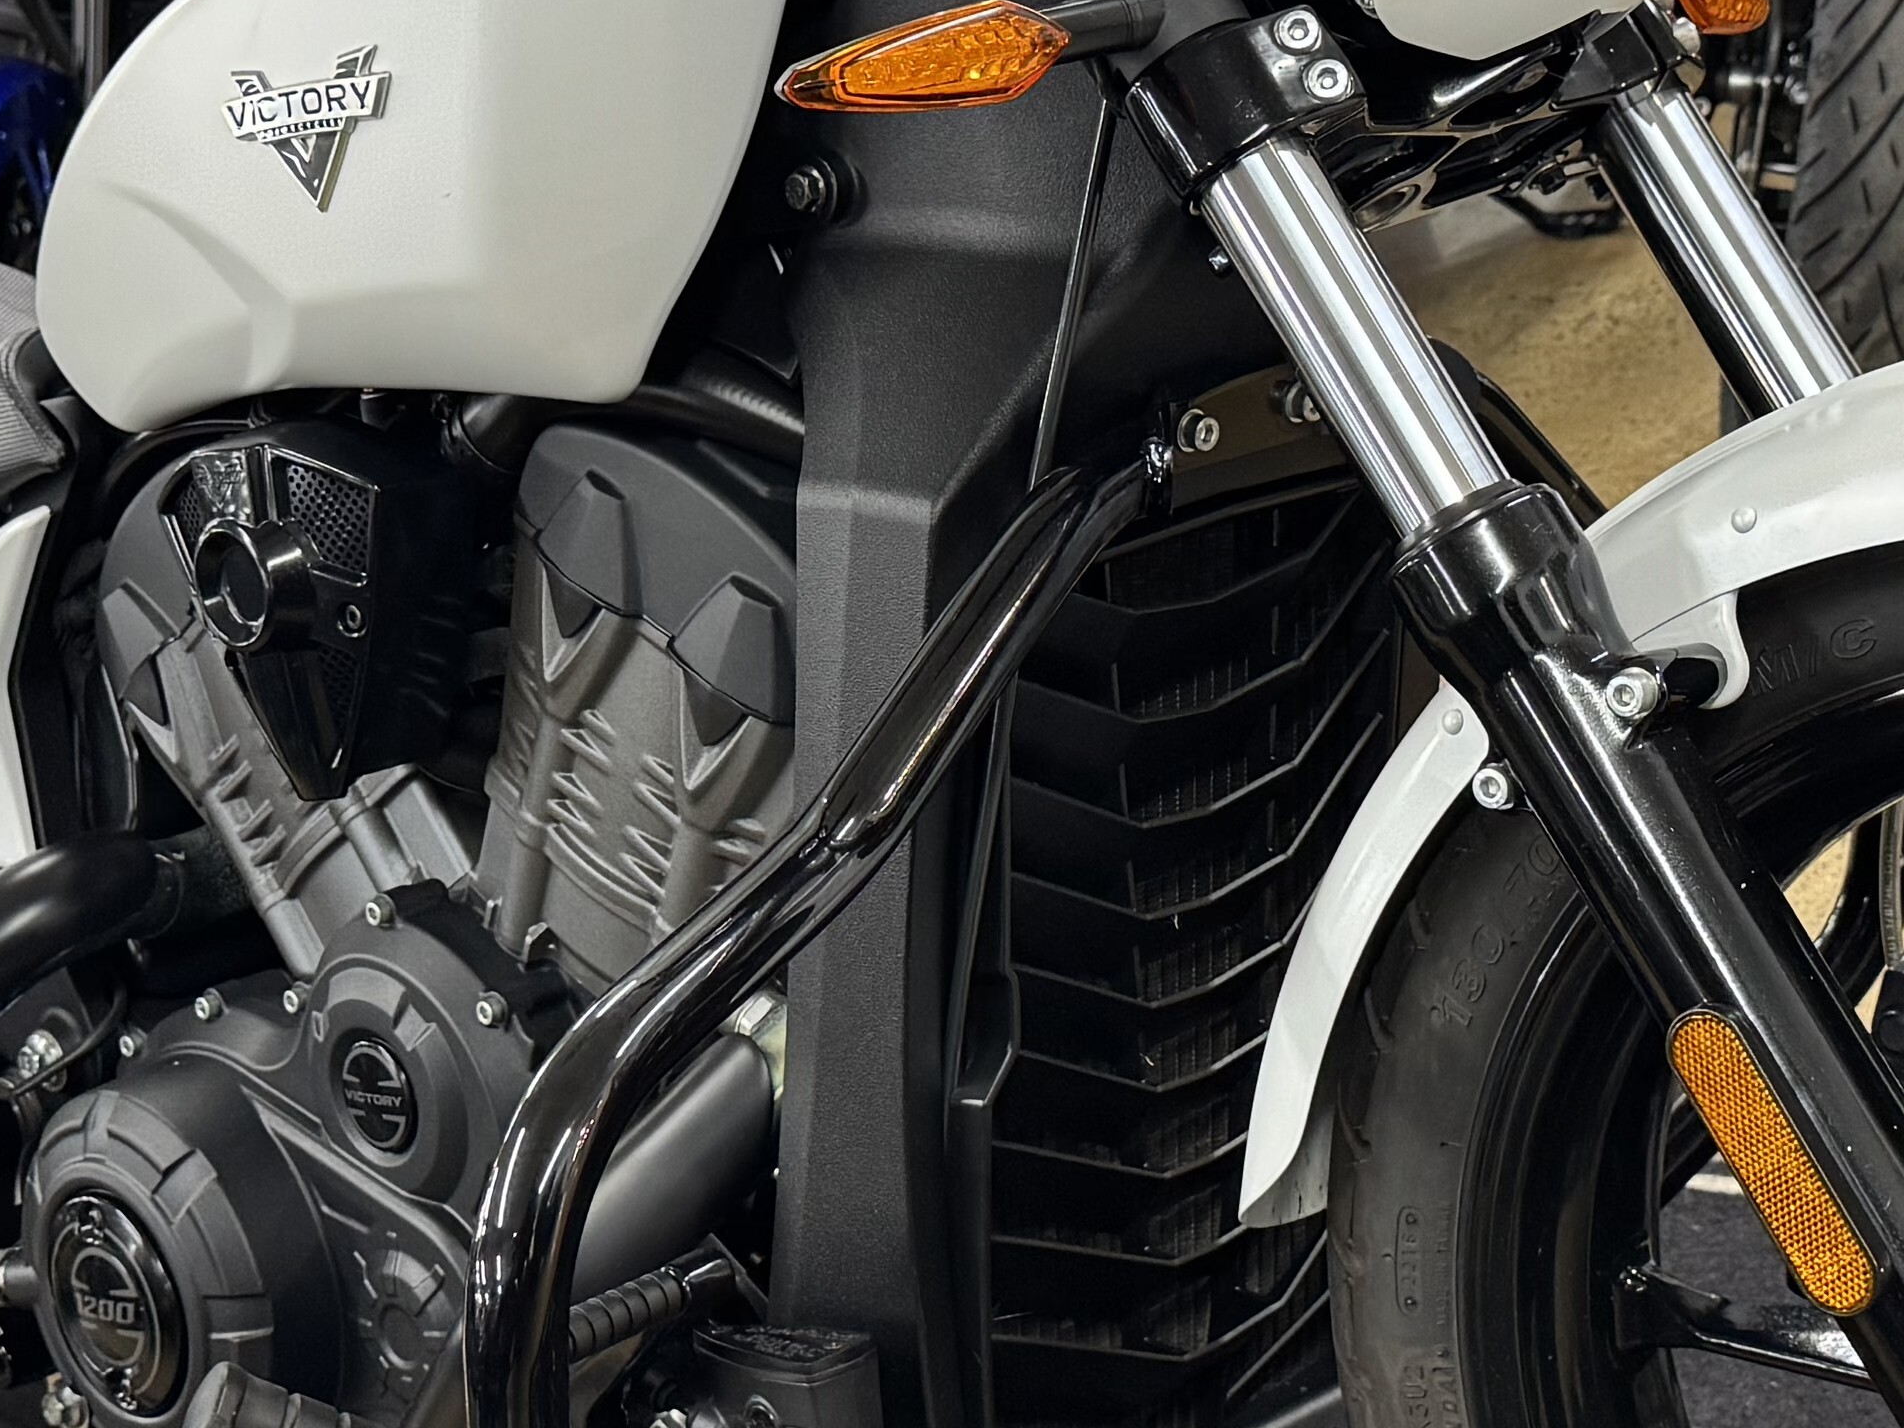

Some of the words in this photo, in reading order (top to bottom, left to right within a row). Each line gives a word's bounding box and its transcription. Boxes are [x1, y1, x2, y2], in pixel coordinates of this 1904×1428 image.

[226, 80, 371, 130] VICTORY
[344, 1088, 402, 1108] VICTORY
[75, 1291, 135, 1324] 1200
